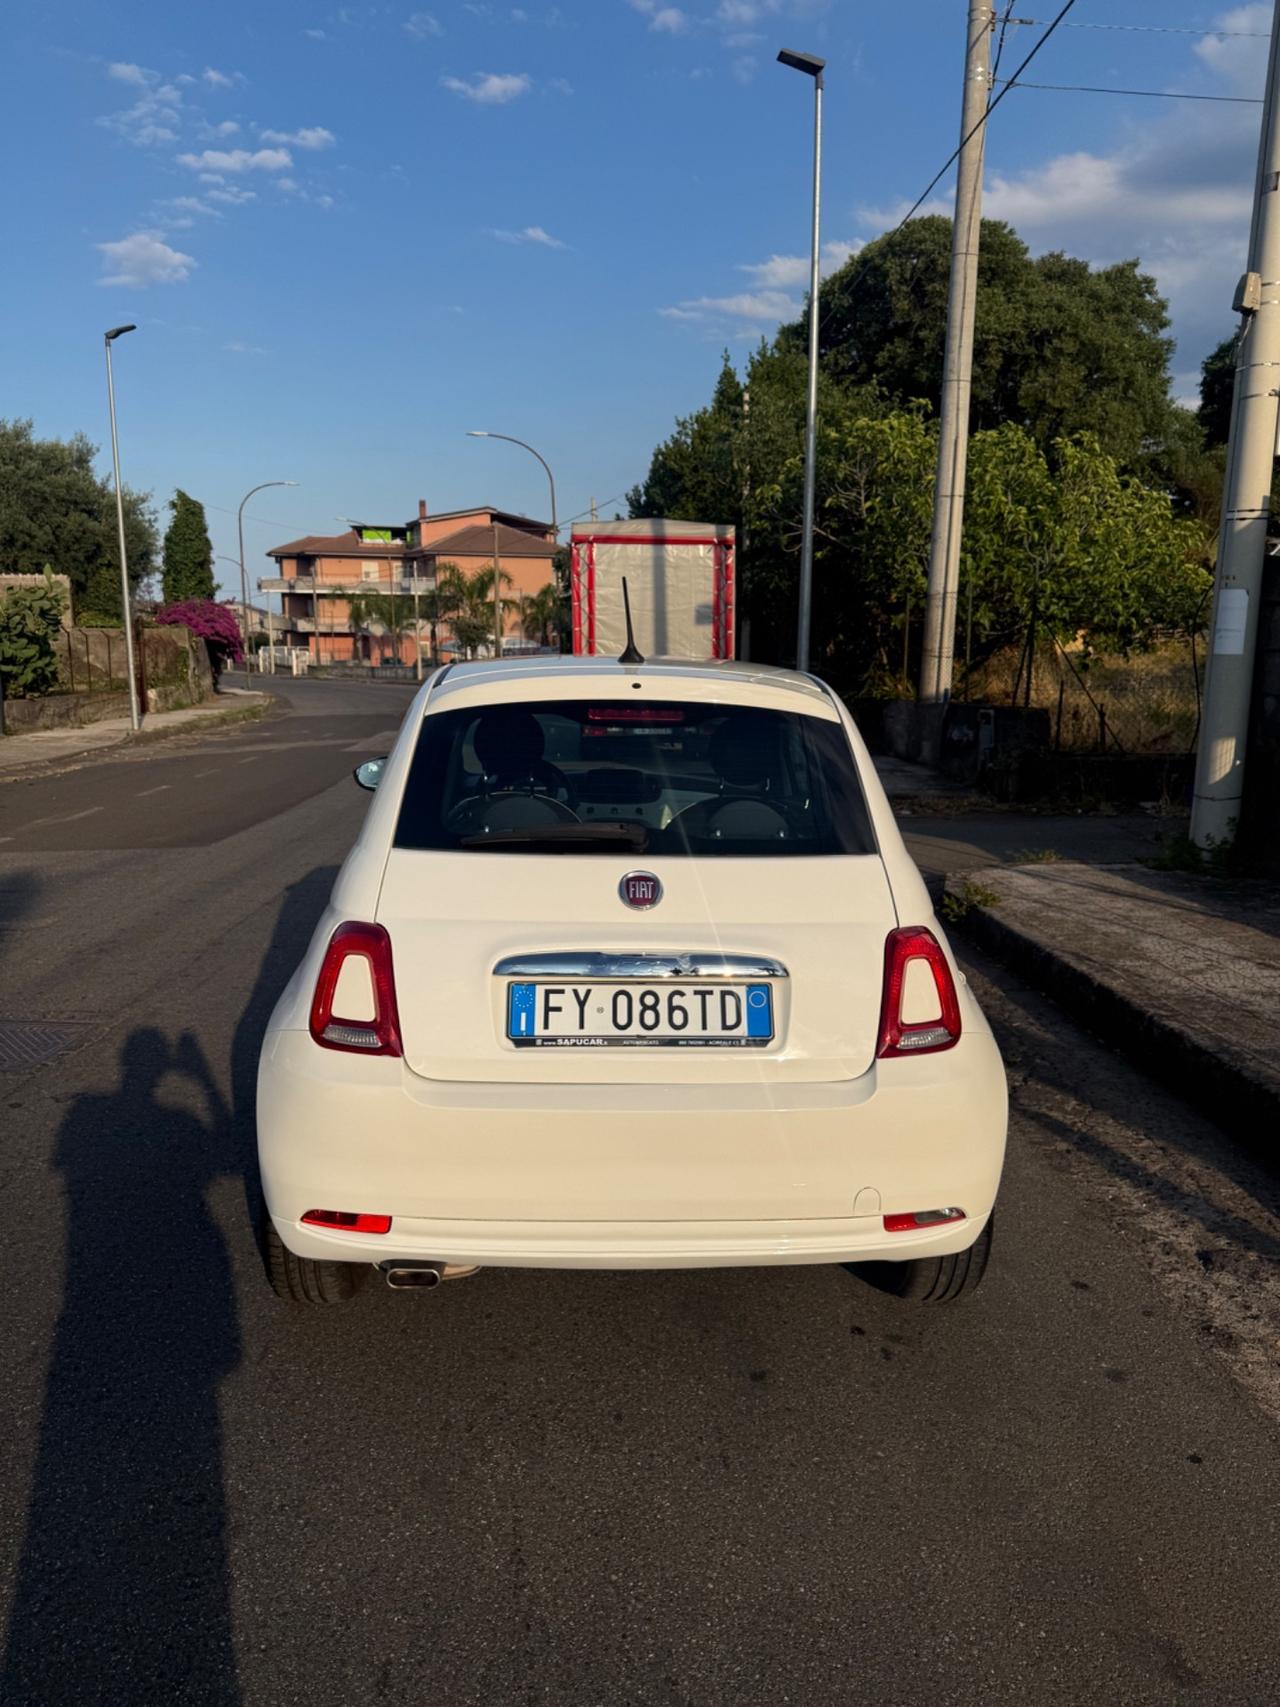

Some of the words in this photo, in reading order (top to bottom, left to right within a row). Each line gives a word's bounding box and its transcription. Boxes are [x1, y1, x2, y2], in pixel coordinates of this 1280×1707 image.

[628, 880, 655, 899] FIAT
[543, 988, 592, 1030] FY
[611, 989, 742, 1031] 086TD
